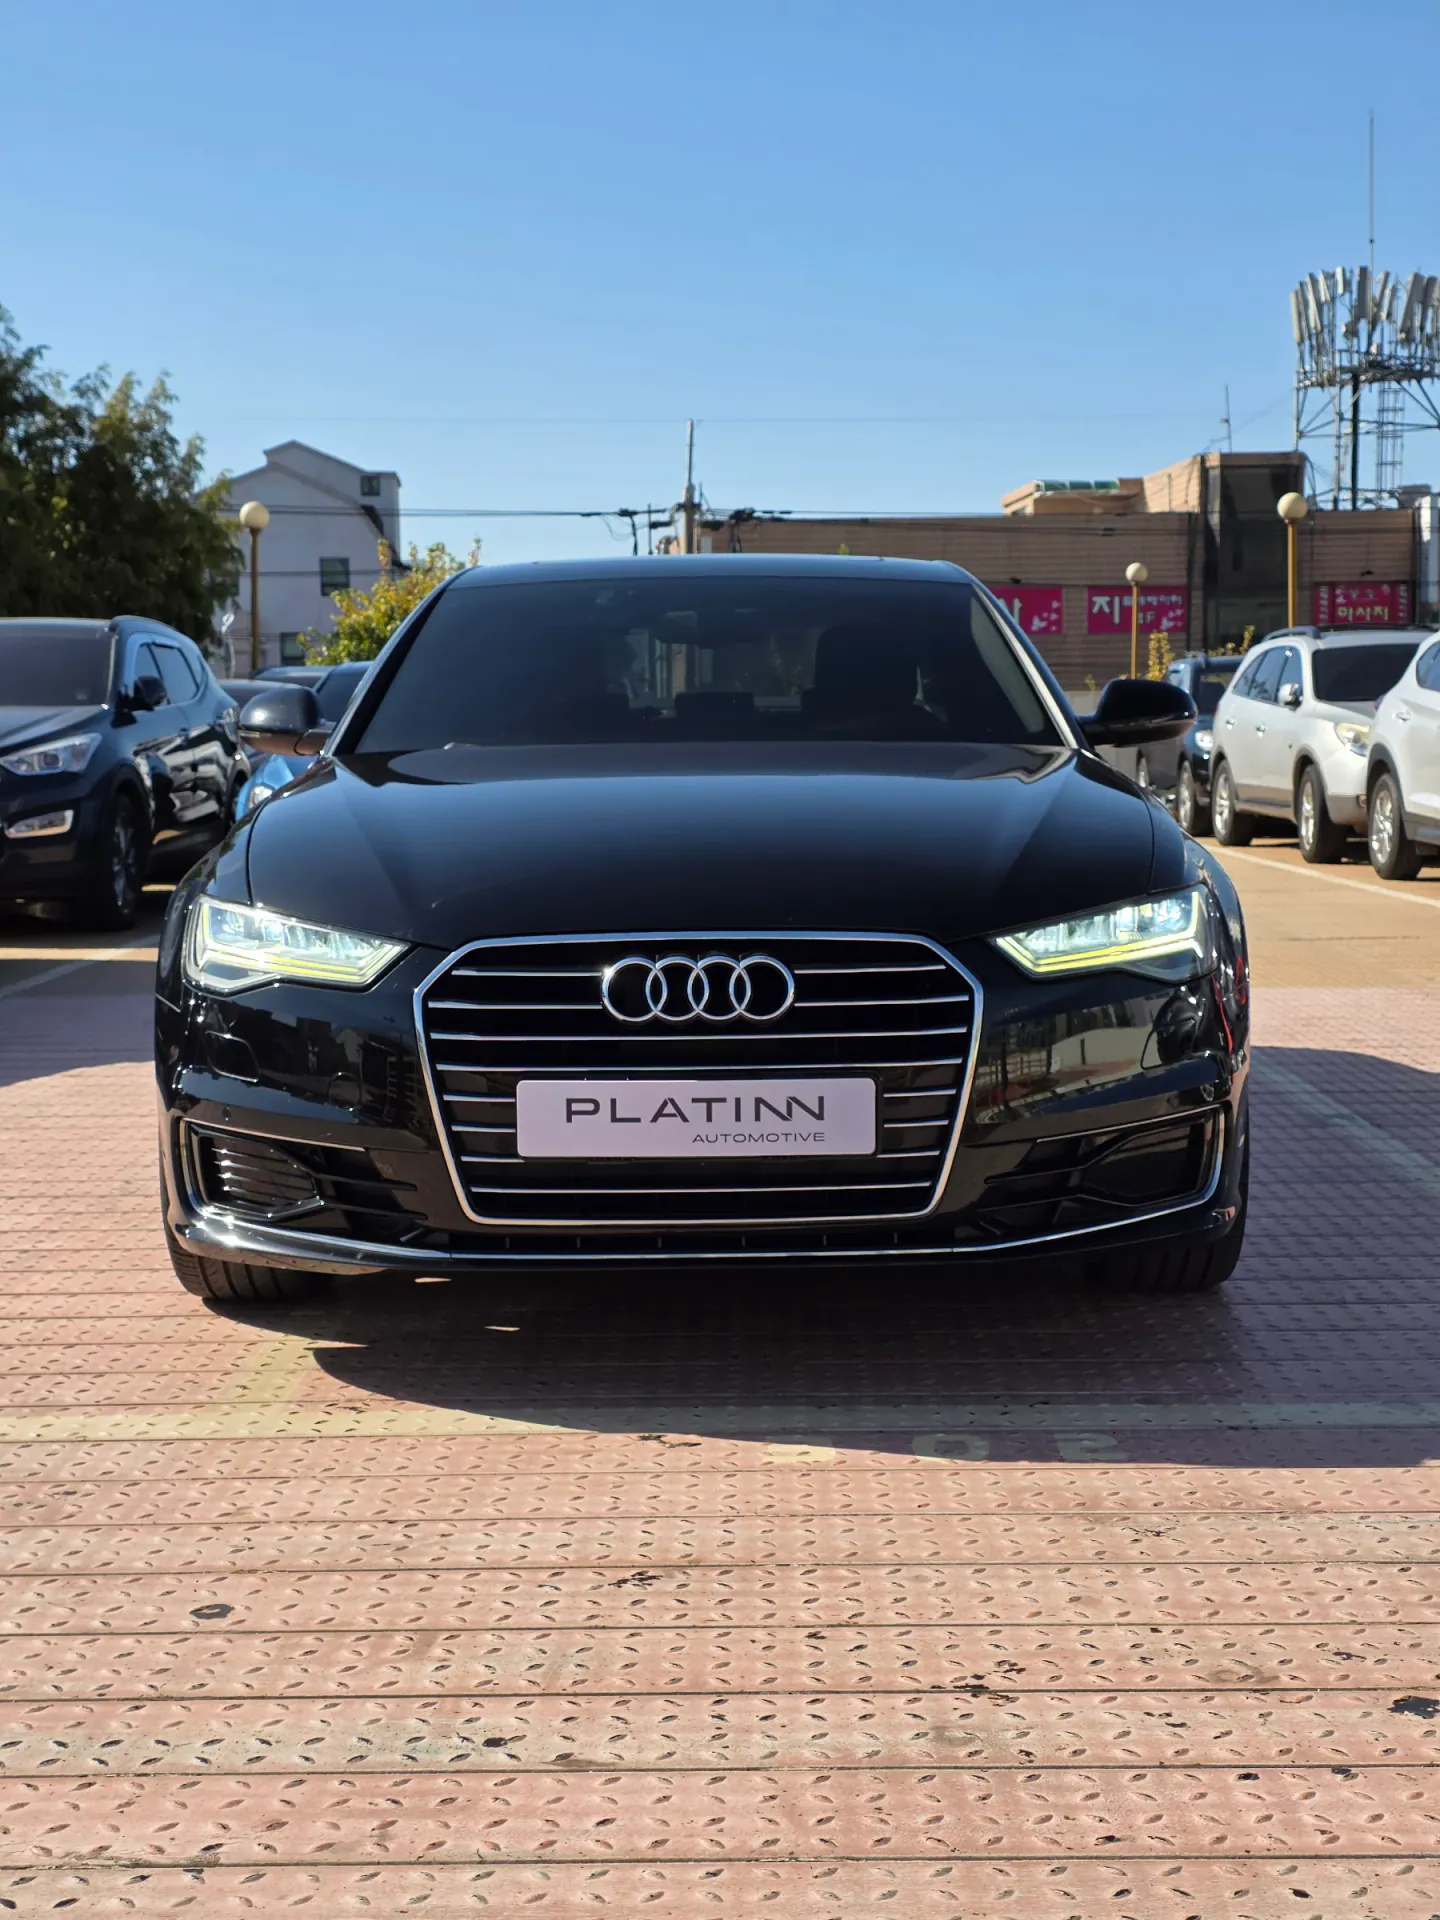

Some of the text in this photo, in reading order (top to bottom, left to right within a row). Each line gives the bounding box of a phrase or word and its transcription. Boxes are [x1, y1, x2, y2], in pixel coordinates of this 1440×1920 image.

[1092, 595, 1121, 625] 지
[1337, 605, 1389, 622] 마사지
[565, 1095, 826, 1123] PLATINN
[691, 1131, 826, 1144] AUTOMOTIVE
